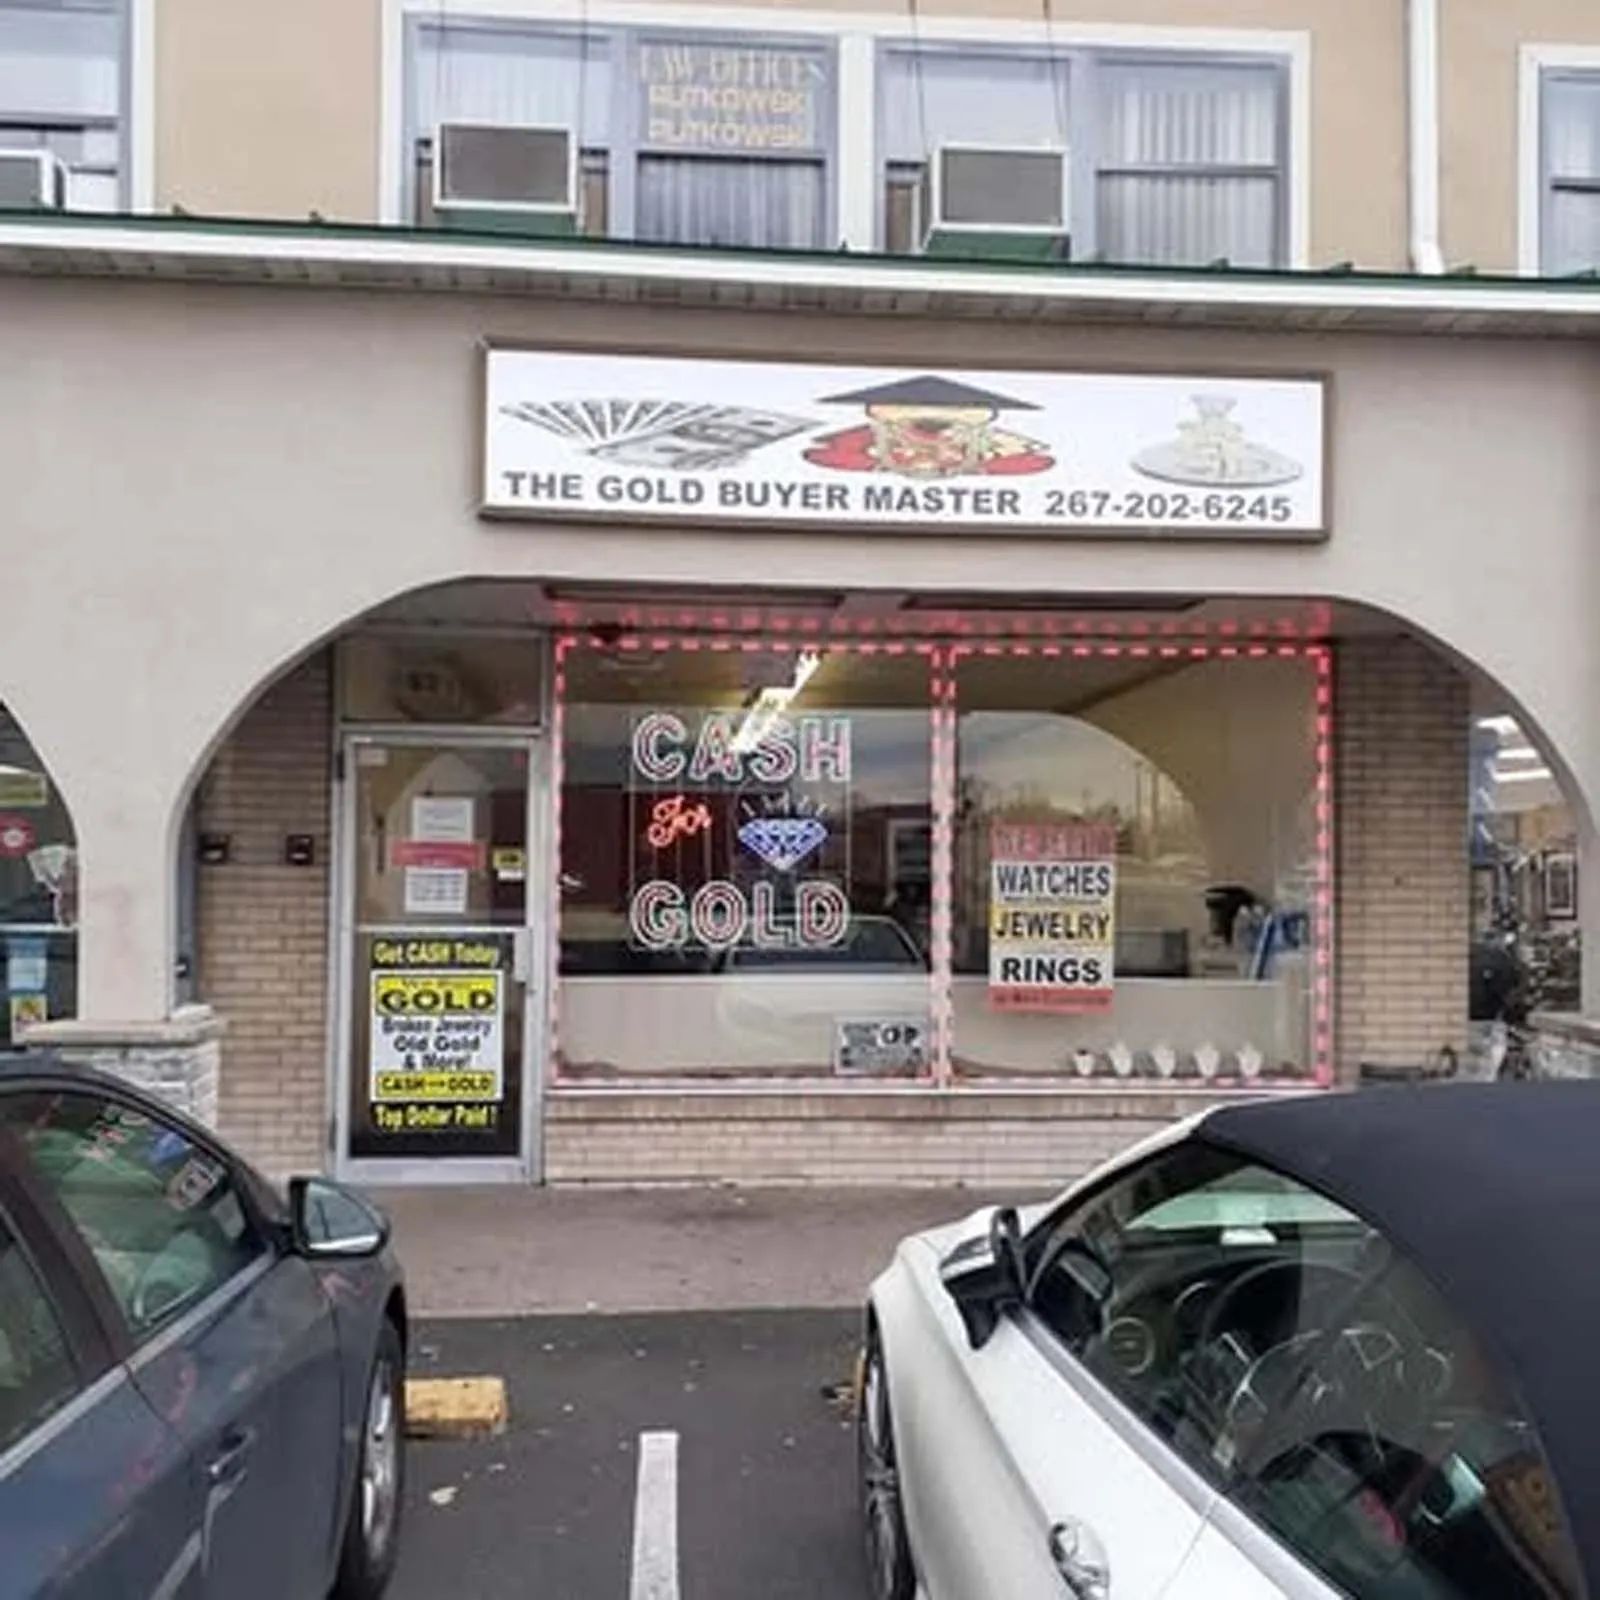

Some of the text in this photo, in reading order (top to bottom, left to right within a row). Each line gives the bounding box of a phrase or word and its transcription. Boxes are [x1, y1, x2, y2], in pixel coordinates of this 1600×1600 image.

[504, 471, 1292, 523] THE GOLD BUYER MASTER 267-202-6245
[632, 713, 852, 782] CASH
[997, 865, 1111, 896] WATCHES
[630, 880, 850, 952] GOLD
[995, 912, 1111, 939] JEWELRY
[1001, 957, 1103, 984] RINGS
[381, 988, 494, 1012] GOLD
[393, 1034, 480, 1052] Old Gold
[448, 1076, 491, 1092] GOLD
